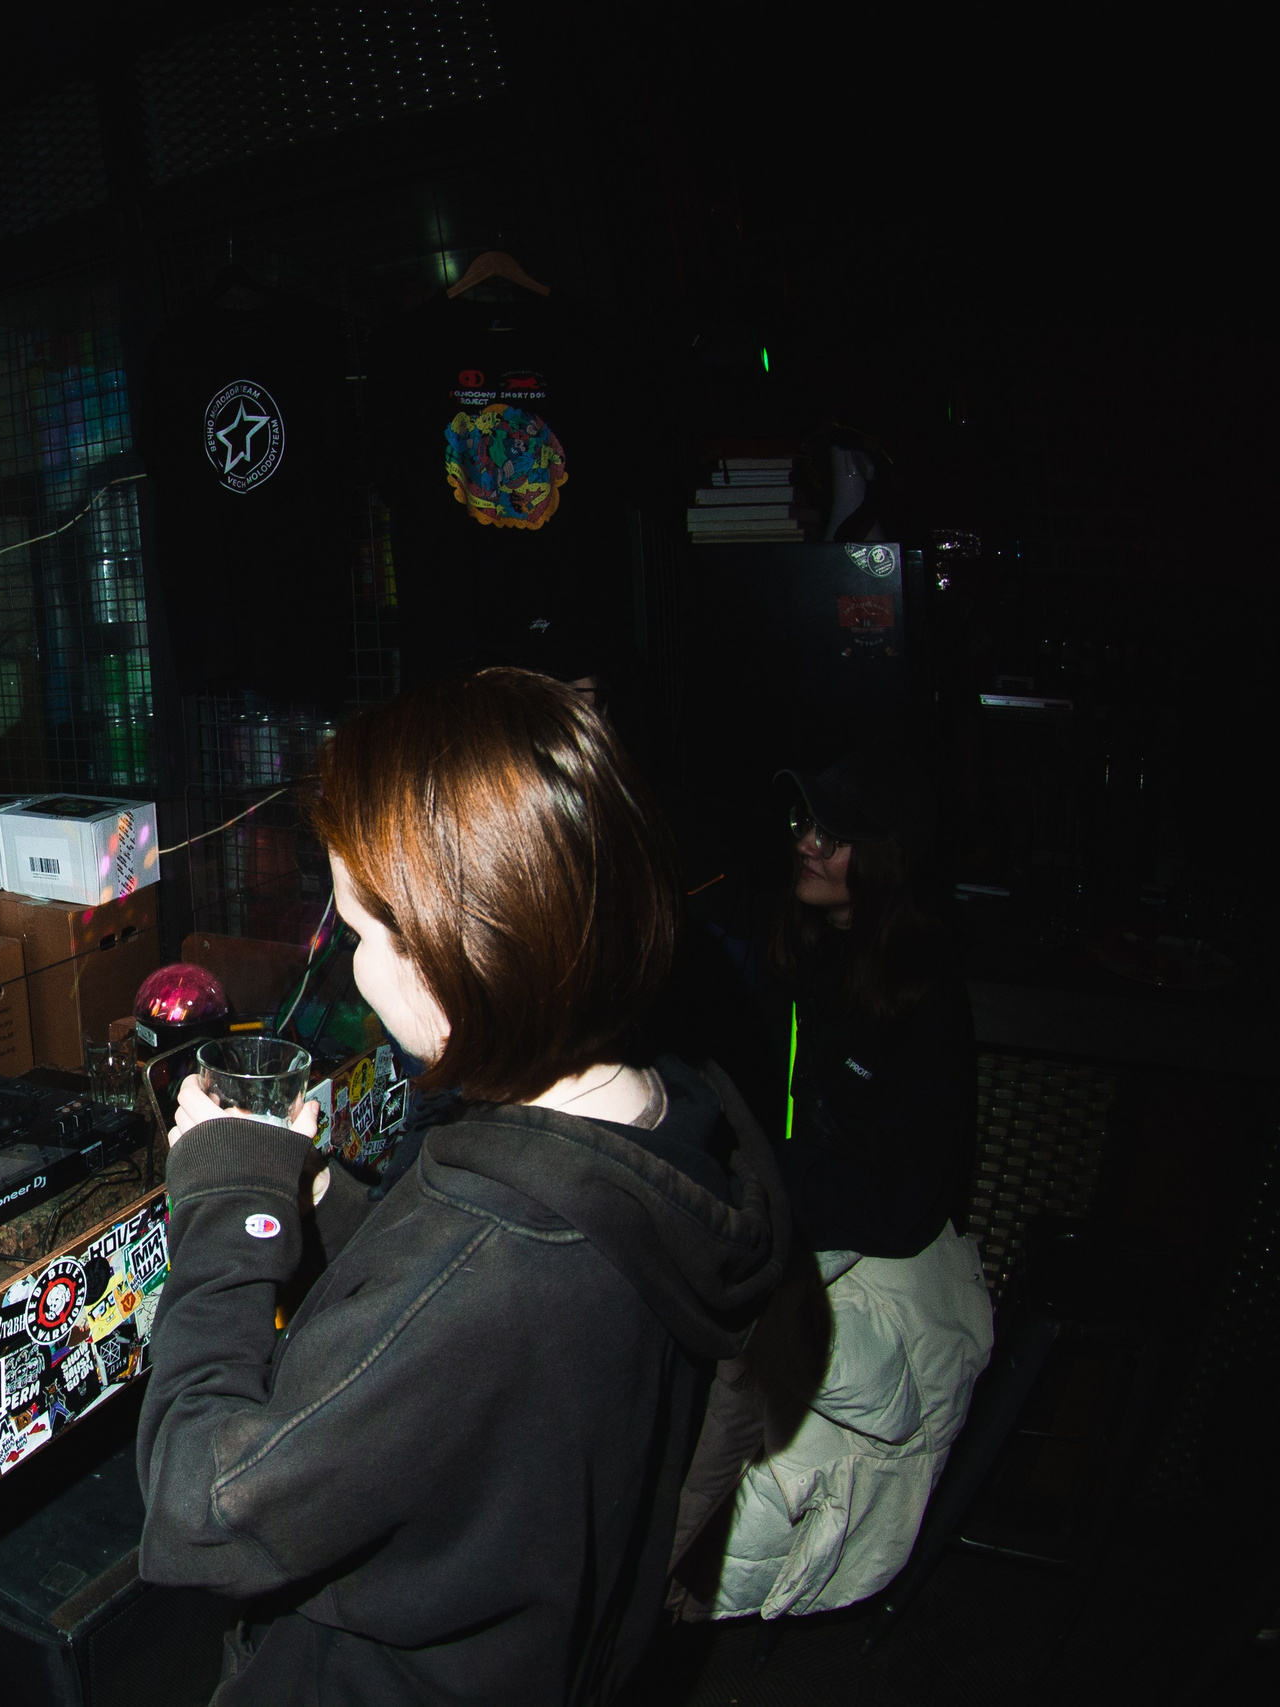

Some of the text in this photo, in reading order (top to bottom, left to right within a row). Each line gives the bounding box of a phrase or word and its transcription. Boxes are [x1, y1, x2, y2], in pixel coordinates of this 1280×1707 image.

[209, 385, 240, 420] МОЛОДОЙ
[500, 391, 528, 399] SMOKY
[529, 391, 546, 399] DOG
[206, 419, 218, 452] ВЕЧНО
[245, 446, 278, 485] MOLODOY
[270, 418, 281, 446] TEAM
[33, 1176, 47, 1189] DJ
[36, 1286, 86, 1343] WARRIORS
[61, 1342, 90, 1371] SHOW
[63, 1352, 92, 1380] MUST
[64, 1361, 95, 1392] GO ON
[5, 1380, 41, 1411] PERM
